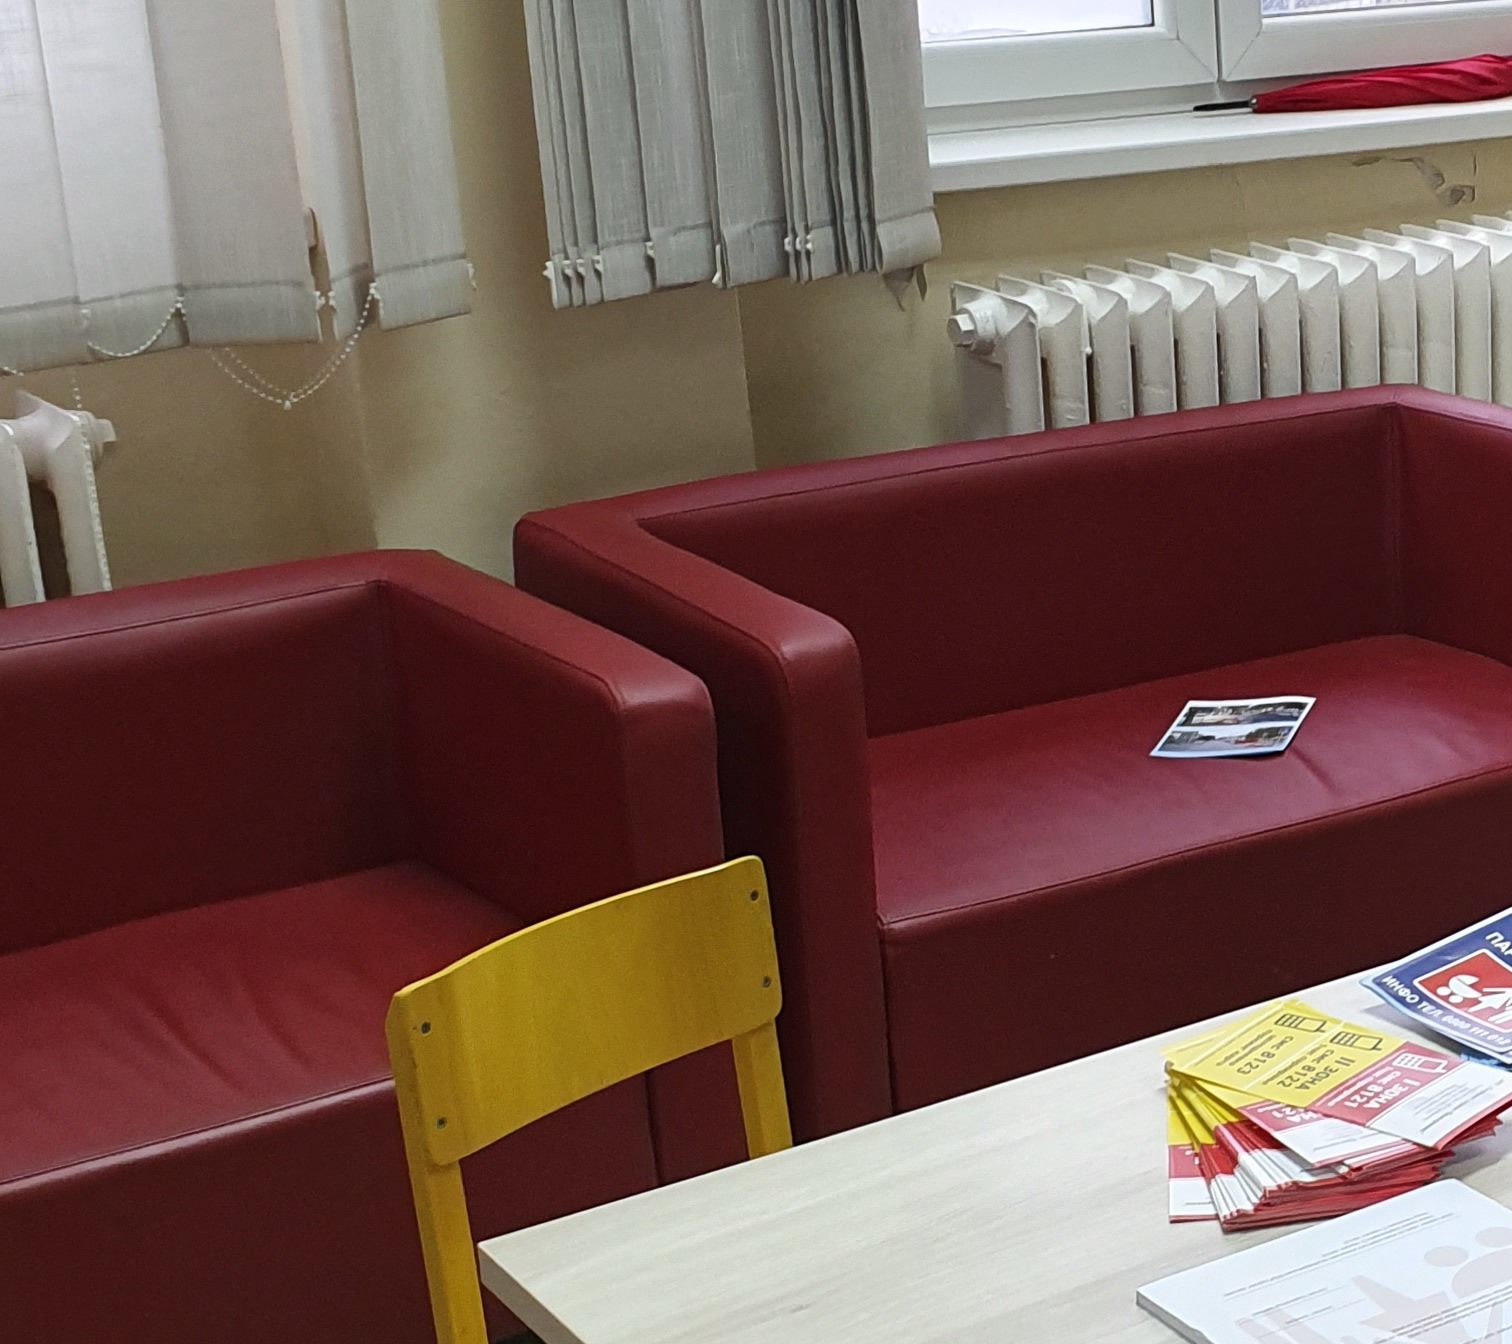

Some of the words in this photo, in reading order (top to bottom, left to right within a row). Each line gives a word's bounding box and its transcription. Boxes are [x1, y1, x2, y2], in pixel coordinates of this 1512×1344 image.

[1382, 975, 1419, 1004] ИНФО
[1237, 1051, 1275, 1075] 8123
[1276, 1065, 1316, 1088] 8122
[1295, 1065, 1339, 1090] ЗОНА
[1344, 1083, 1383, 1108] 8121
[1363, 1084, 1409, 1109] ЗОНА
